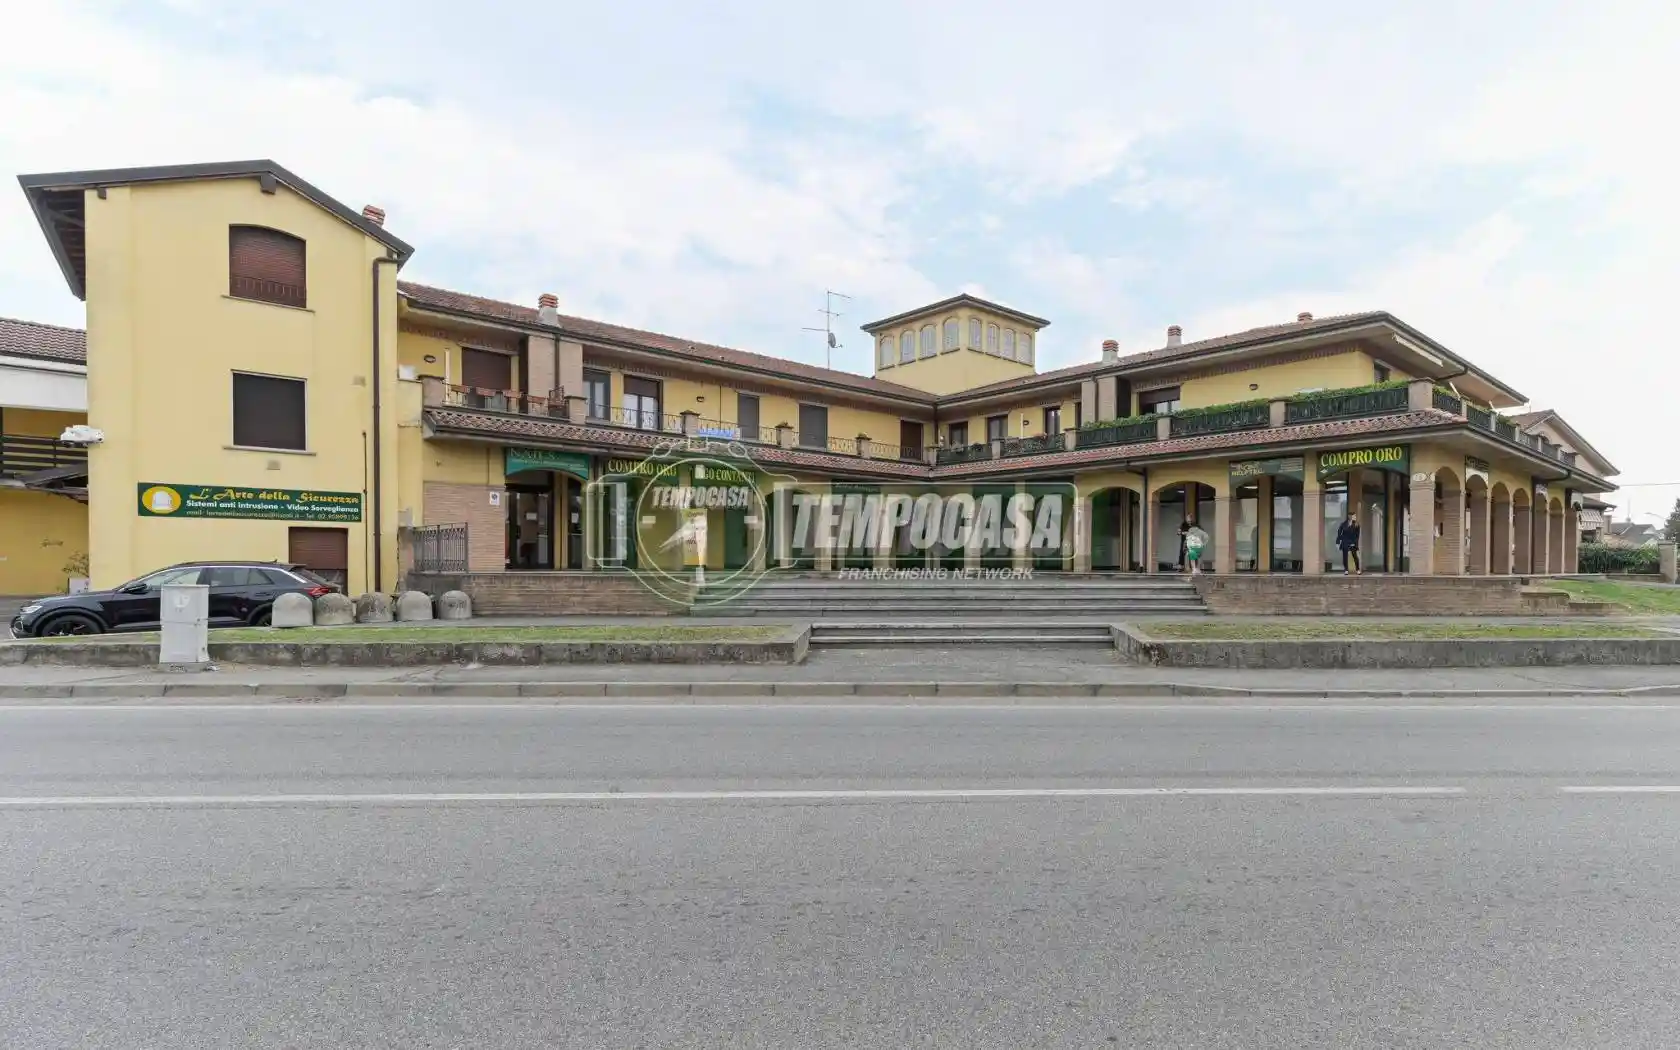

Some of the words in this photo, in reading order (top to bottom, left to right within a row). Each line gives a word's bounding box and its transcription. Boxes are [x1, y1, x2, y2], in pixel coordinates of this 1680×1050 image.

[1321, 449, 1373, 467] COMPRO
[1375, 446, 1403, 463] ORO
[608, 460, 654, 475] COMPRO
[259, 491, 290, 500] della
[296, 492, 359, 504] Sicurezza
[186, 500, 217, 508] Sistemi
[219, 501, 236, 509] anti
[238, 502, 278, 511] intrusione
[286, 503, 309, 511] Video
[311, 504, 359, 513] Sorveglianza
